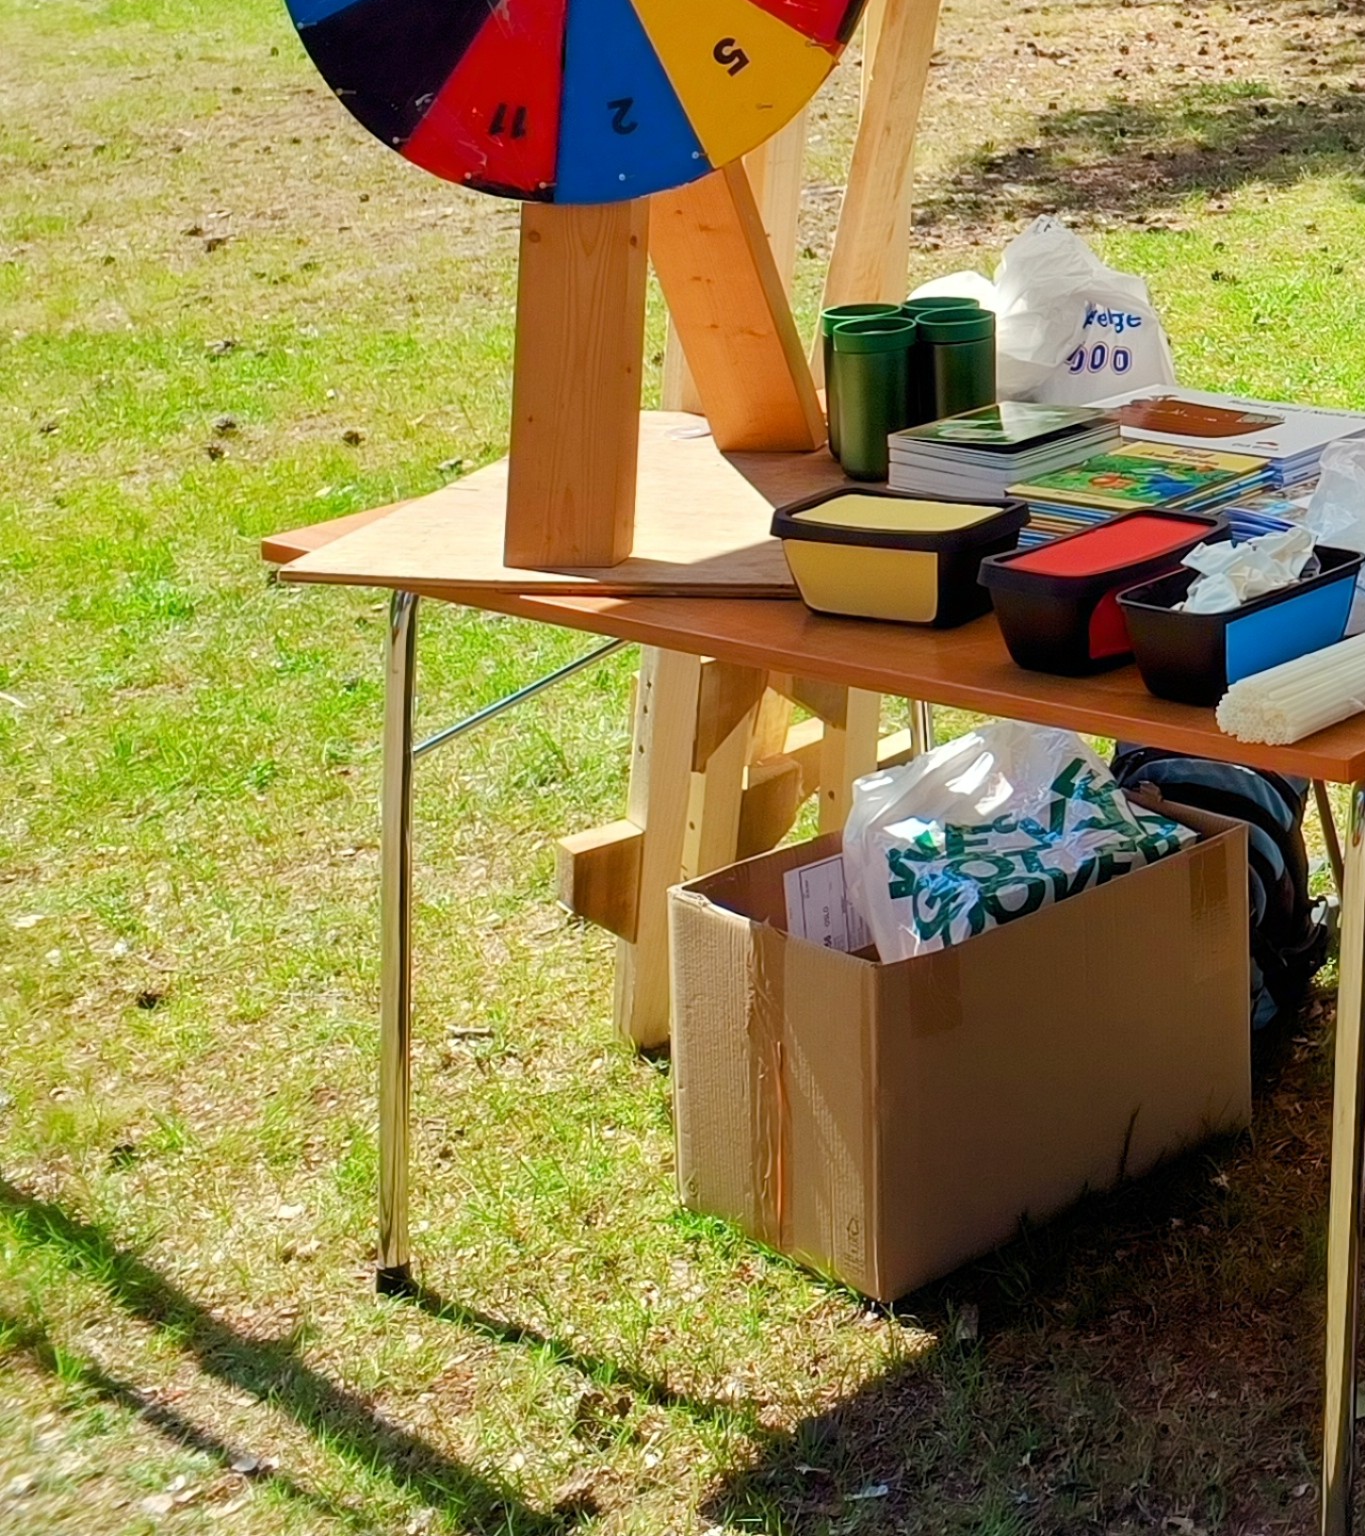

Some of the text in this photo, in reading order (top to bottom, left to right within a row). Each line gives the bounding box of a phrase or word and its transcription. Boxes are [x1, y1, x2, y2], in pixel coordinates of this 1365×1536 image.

[712, 37, 750, 77] 5
[489, 101, 528, 139] 11
[606, 97, 639, 136] 2
